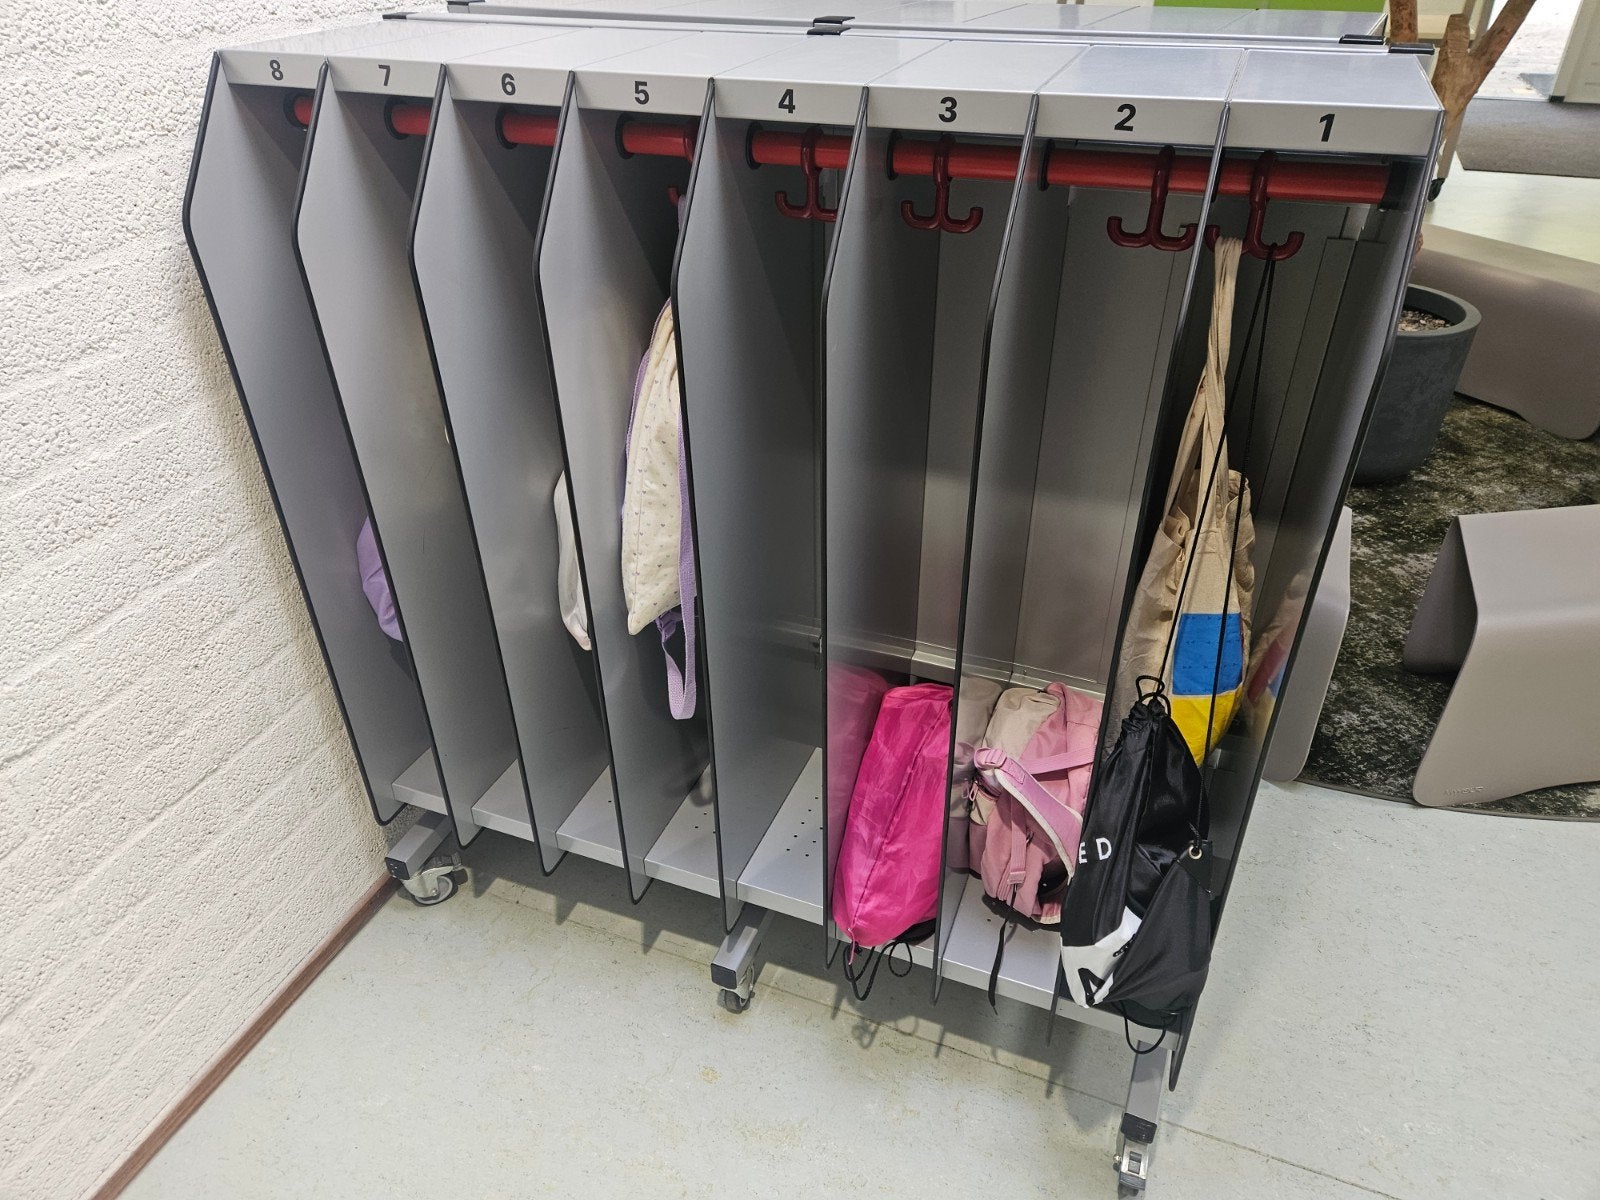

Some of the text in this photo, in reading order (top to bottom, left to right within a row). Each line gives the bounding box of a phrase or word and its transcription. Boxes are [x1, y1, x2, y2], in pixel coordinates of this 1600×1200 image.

[270, 60, 283, 80] 8
[378, 65, 391, 86] 7
[502, 73, 515, 95] 6
[634, 81, 649, 105] 5
[778, 89, 795, 113] 4
[939, 97, 957, 122] 3
[1114, 104, 1136, 131] 2
[1319, 114, 1335, 142] 1
